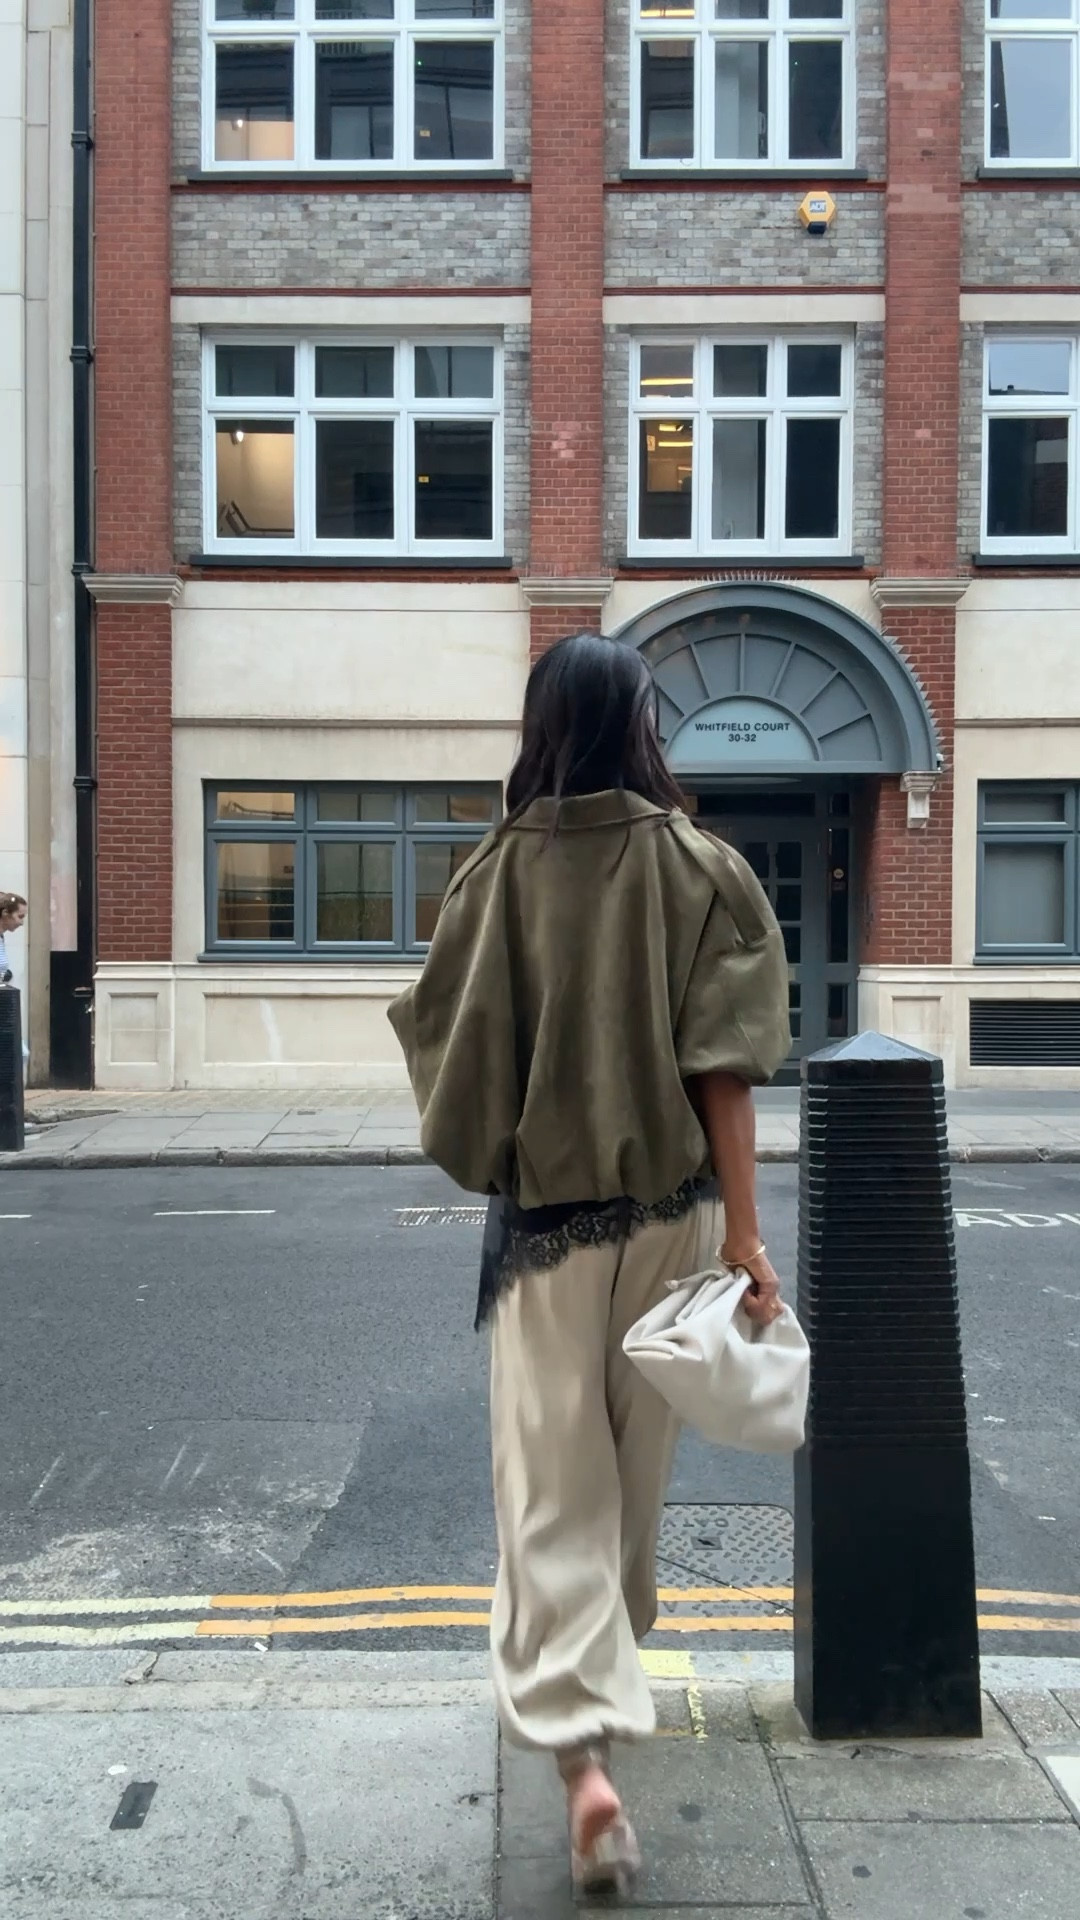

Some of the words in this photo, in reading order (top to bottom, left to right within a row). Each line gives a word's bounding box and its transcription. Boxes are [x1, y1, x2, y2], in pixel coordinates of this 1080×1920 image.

[695, 722, 751, 731] WHITFIELD
[754, 722, 790, 731] COURT
[728, 733, 757, 742] 30-32
